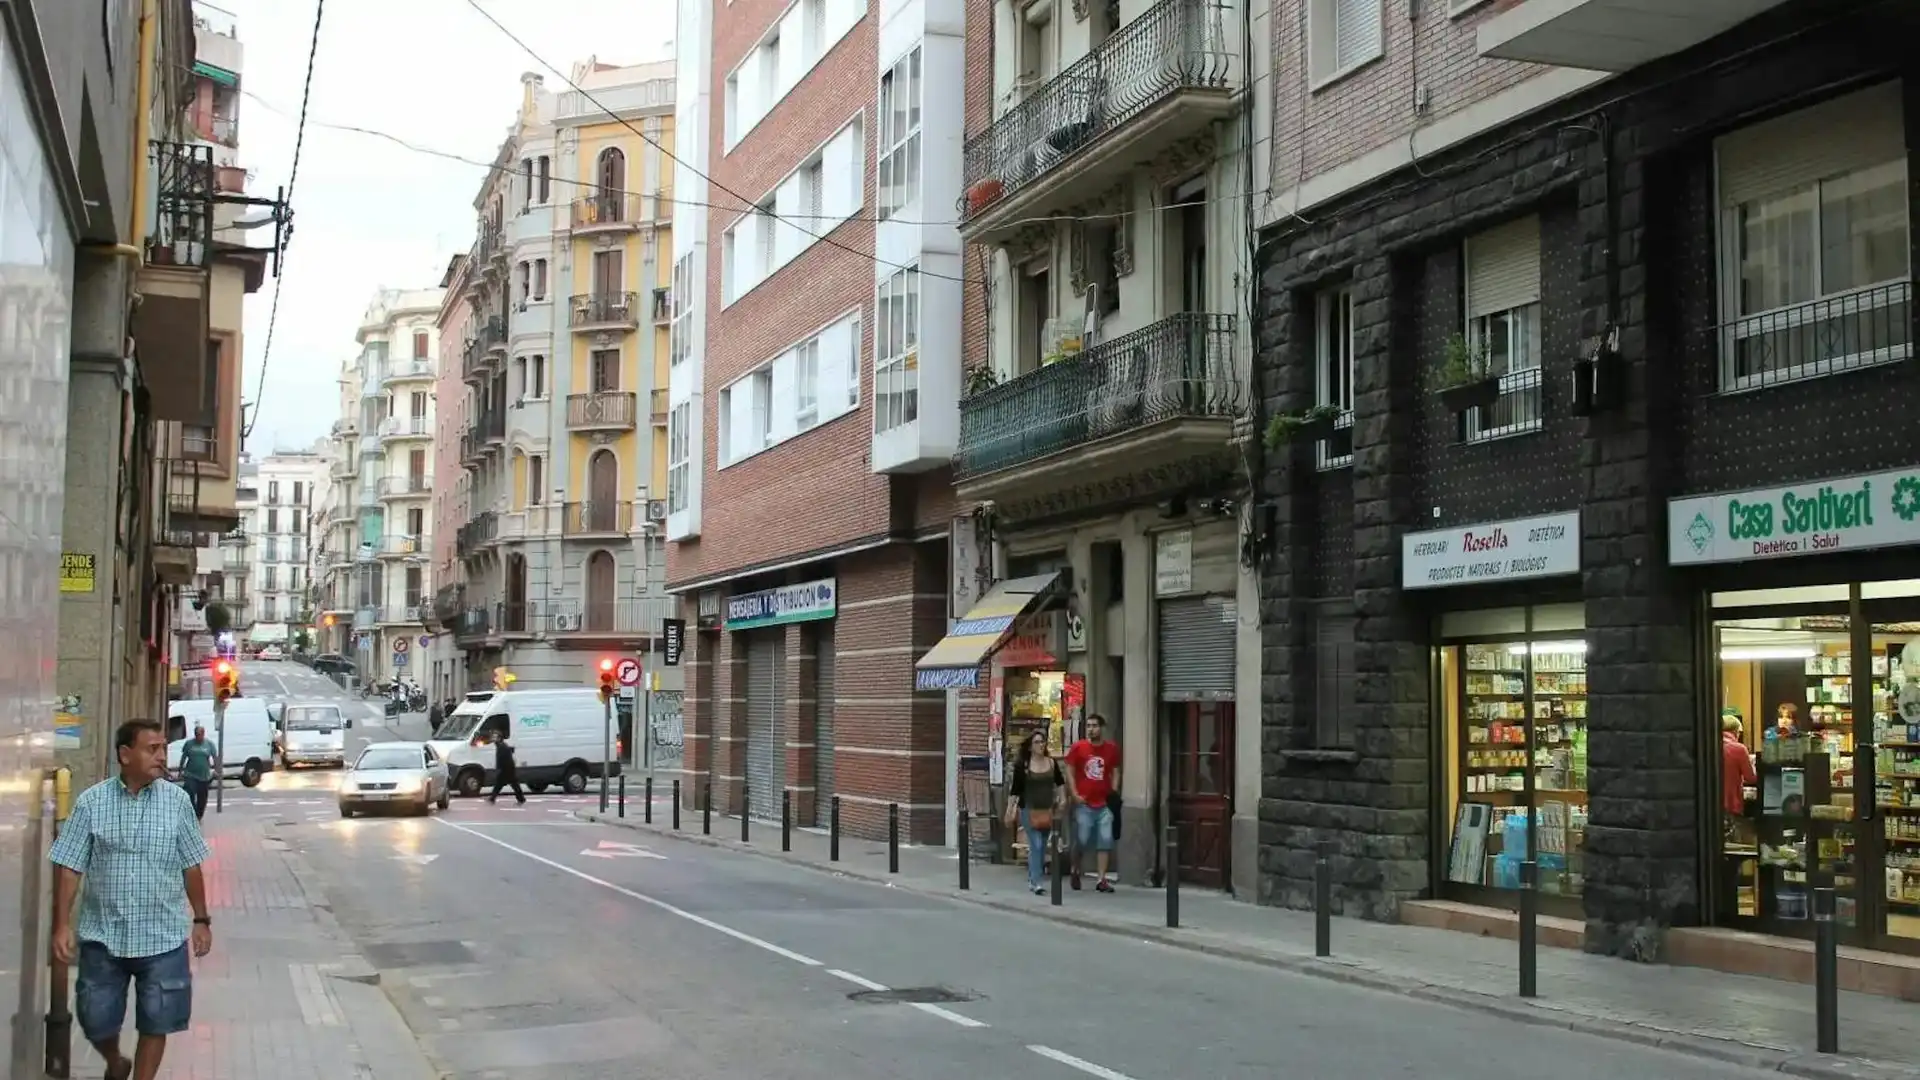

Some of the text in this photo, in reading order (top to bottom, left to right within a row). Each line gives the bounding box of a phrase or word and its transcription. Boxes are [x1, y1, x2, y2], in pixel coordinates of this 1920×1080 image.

[1728, 480, 1873, 540] Casa Santiveri
[1413, 540, 1449, 556] HERBOLARI
[1463, 527, 1509, 553] Rosella
[1753, 539, 1798, 555] Dietètica
[1812, 533, 1840, 550] Salut
[1428, 564, 1466, 581] PRODUCTES
[1467, 559, 1502, 577] NATURALS
[667, 625, 678, 663] KIKIRIKI
